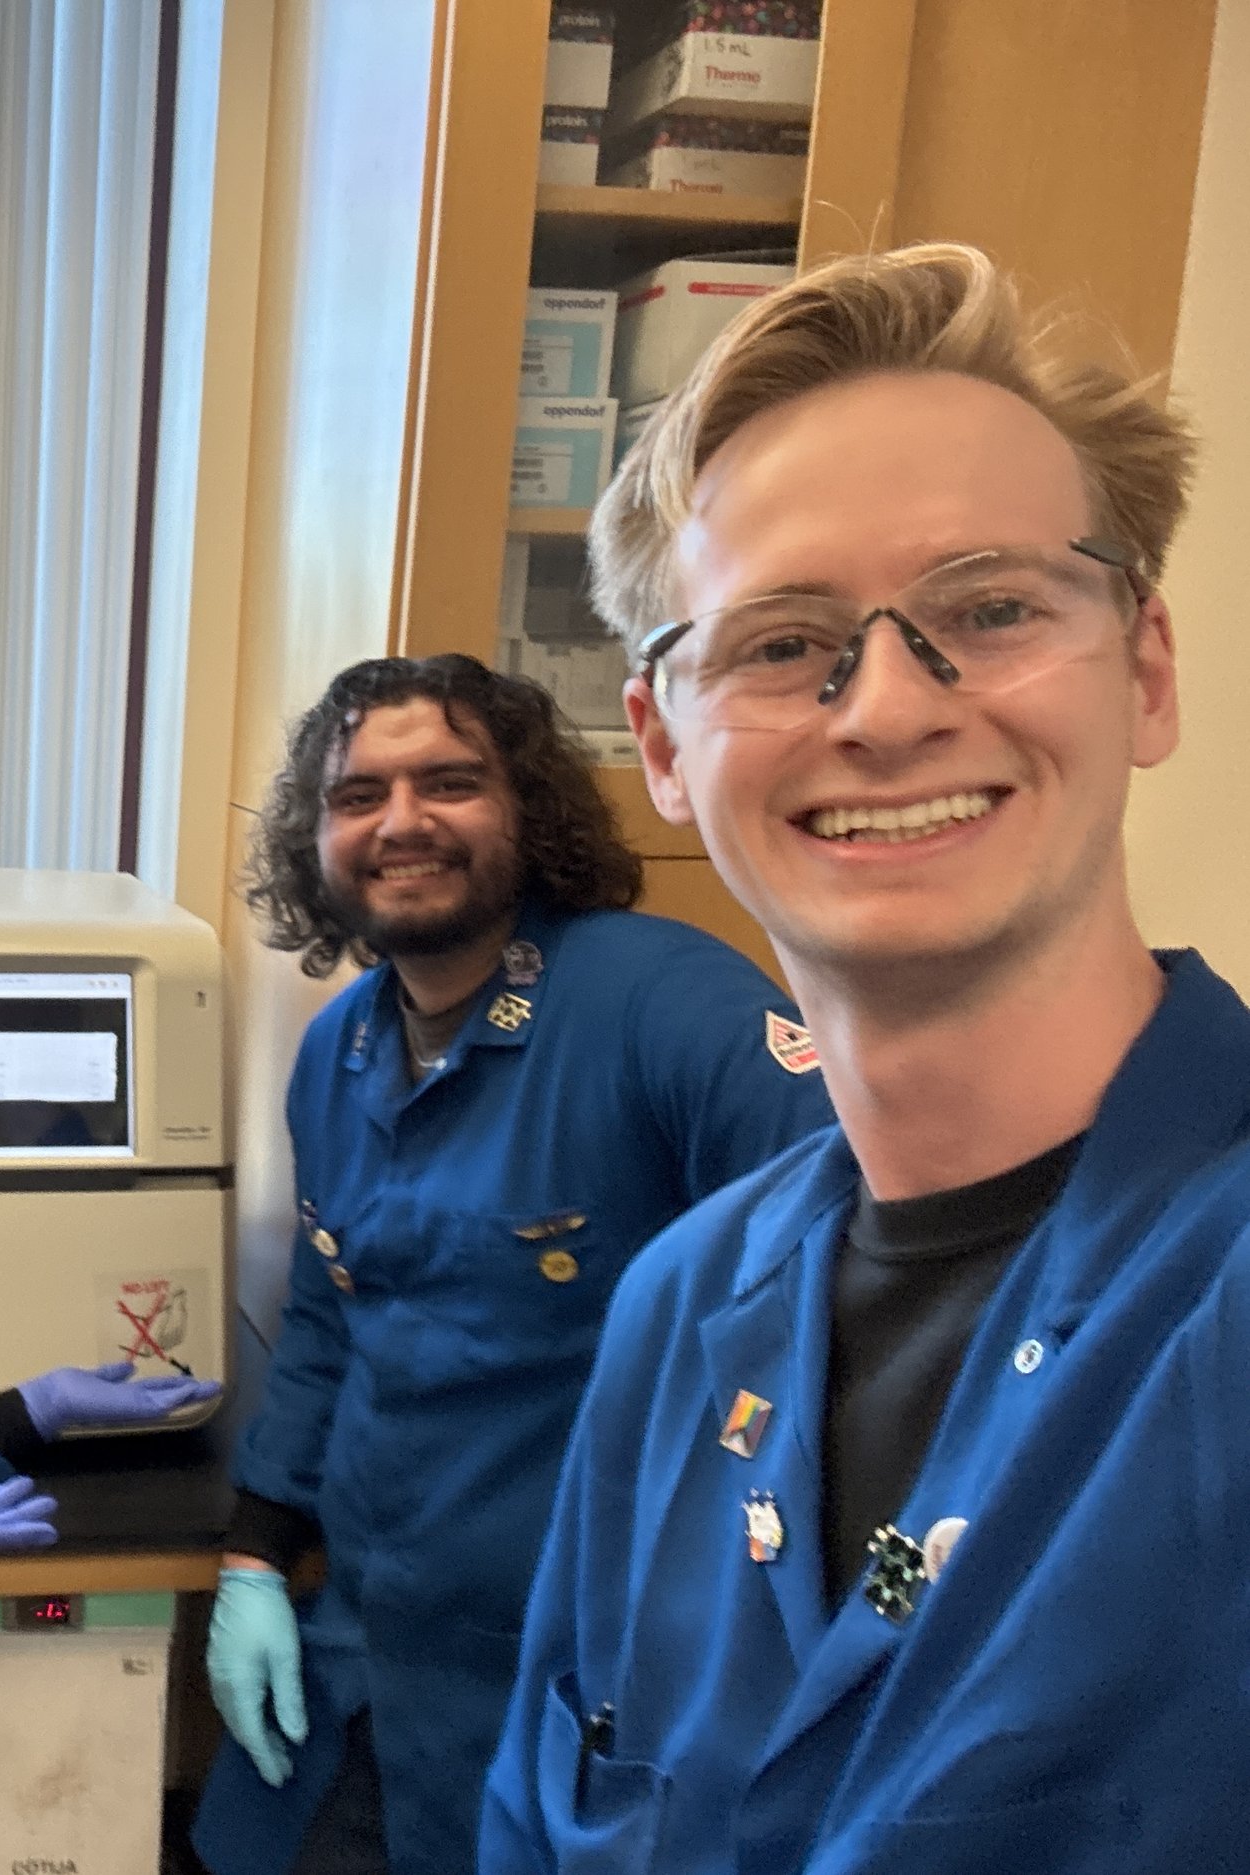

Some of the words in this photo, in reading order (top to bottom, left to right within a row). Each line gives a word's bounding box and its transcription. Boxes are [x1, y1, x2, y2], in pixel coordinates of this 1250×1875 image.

[706, 65, 761, 83] Thermo
[543, 298, 606, 311] eppendorf
[543, 404, 606, 419] eppendorf
